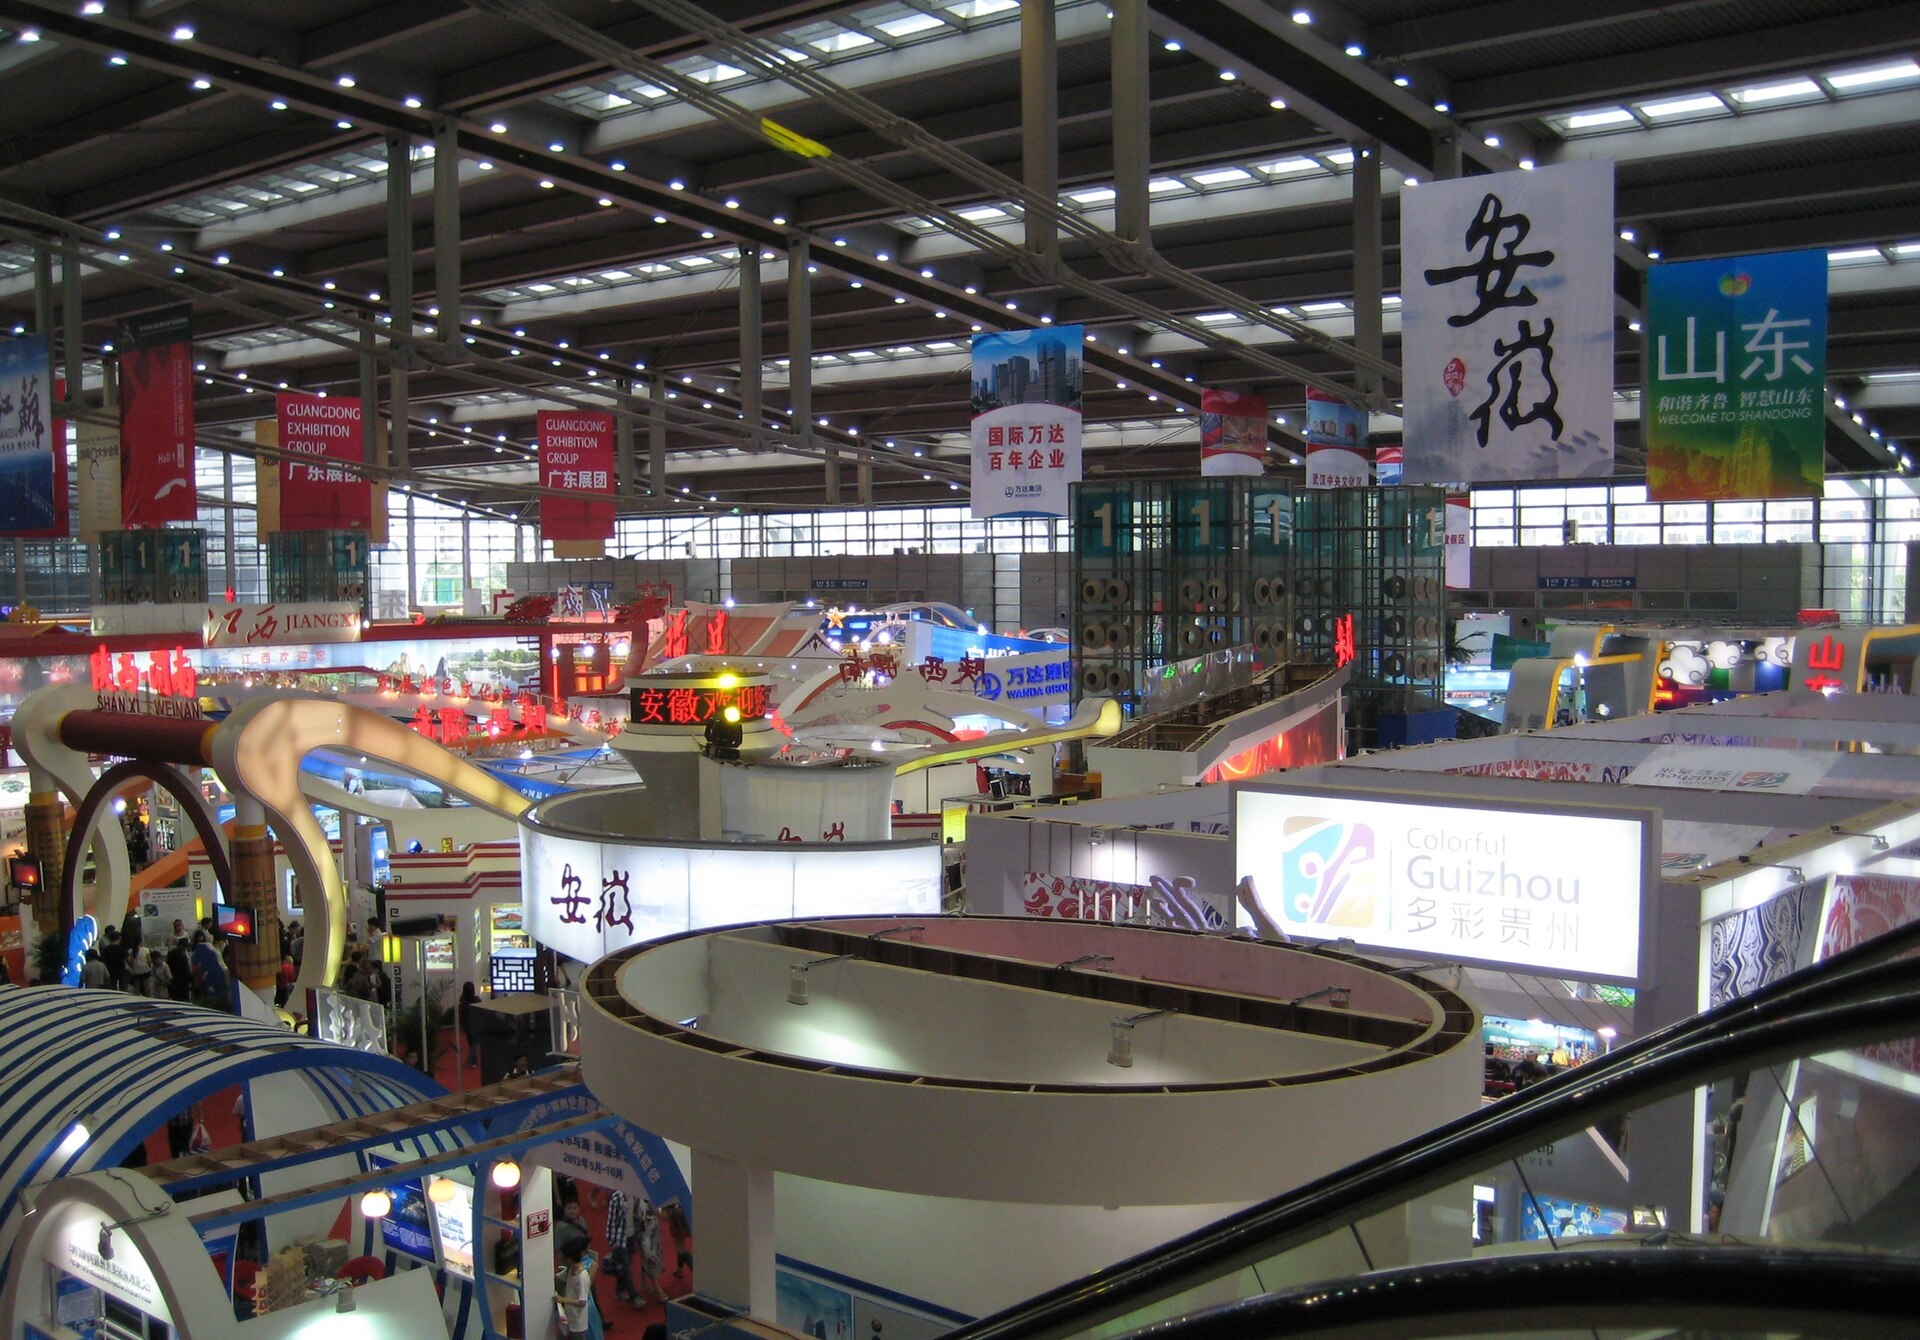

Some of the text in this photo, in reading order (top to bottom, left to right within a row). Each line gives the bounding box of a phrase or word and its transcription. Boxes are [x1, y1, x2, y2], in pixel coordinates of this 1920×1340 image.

[1424, 192, 1563, 448] 安徽
[1657, 308, 1814, 384] 山东
[286, 403, 361, 420] GUANGDONG
[1657, 387, 1814, 413] 和谐齐鲁 智慧山东
[545, 419, 606, 432] GUANGDONG
[1657, 407, 1811, 425] WELCOME TO SHANDONG
[286, 422, 350, 437] EXHIBITION
[988, 423, 1065, 447] 国际万达
[287, 441, 327, 454] GROUP
[546, 436, 597, 448] EXHIBITION
[157, 453, 171, 464] Hall
[546, 452, 579, 464] GROUP
[988, 448, 1065, 471] 百年企业
[548, 470, 607, 489] 广东展团
[1093, 502, 1112, 547] 1
[1191, 499, 1210, 546] 1
[1266, 496, 1280, 545] 1
[1424, 506, 1436, 547] 1
[179, 541, 191, 568] 1
[345, 541, 357, 567] 1
[207, 604, 278, 646] 江西
[284, 612, 361, 633] JIANGXI
[240, 650, 326, 665] 江西欢迎您
[1007, 683, 1071, 700] WANDA GROU
[153, 698, 202, 720] WEINAN
[1406, 826, 1506, 856] Colorful
[1406, 854, 1580, 905] Guizhou
[550, 862, 635, 936] 安徽
[1407, 896, 1579, 953] 多彩贵州
